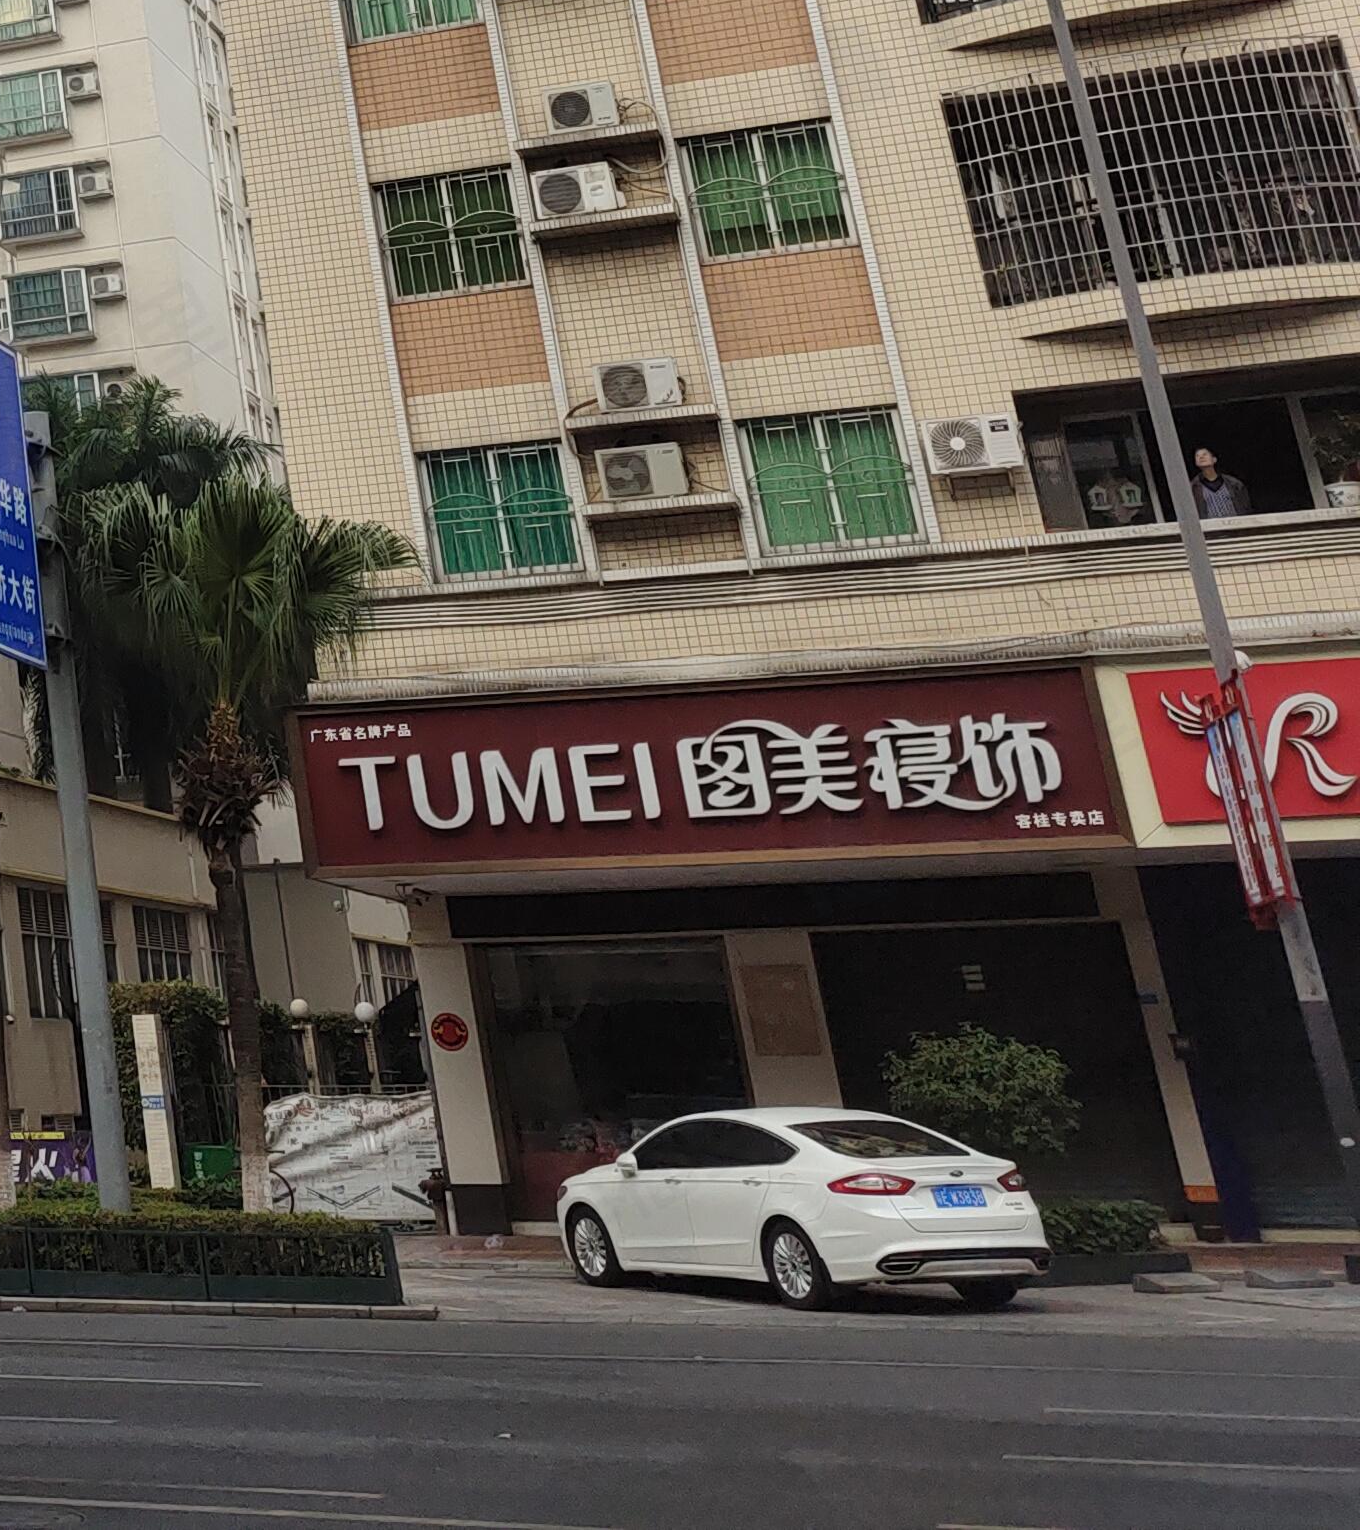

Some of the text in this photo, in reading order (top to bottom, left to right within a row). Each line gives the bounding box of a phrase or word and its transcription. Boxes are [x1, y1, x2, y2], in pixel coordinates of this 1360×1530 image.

[310, 723, 411, 742] 广东省名牌产品
[338, 713, 1062, 831] TUMEI 图美寝饰
